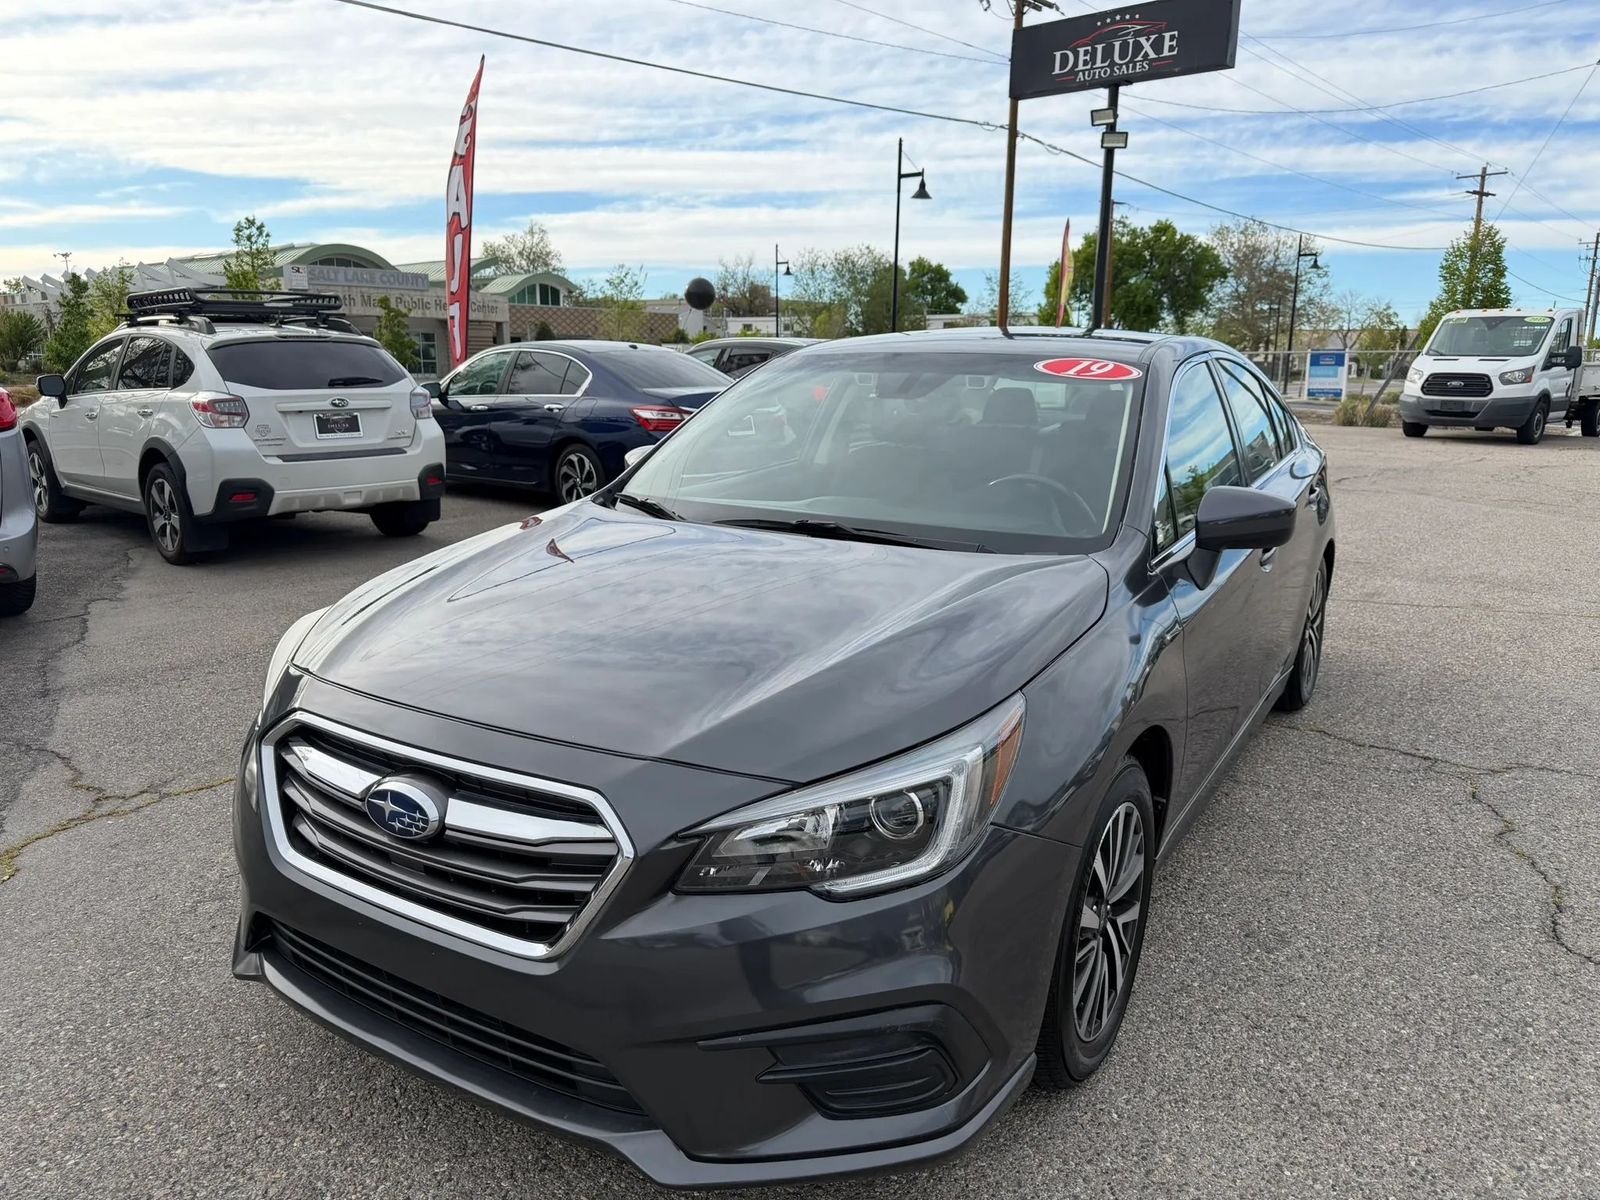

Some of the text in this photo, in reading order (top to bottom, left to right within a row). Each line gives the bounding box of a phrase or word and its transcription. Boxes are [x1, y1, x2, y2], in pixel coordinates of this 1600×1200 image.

[1051, 30, 1179, 75] DELUXE
[1076, 61, 1150, 82] AUTO SALES
[308, 268, 428, 288] SALT LAKE COUNTY
[395, 296, 432, 311] Public
[470, 301, 499, 315] Center
[1060, 360, 1115, 376] 19
